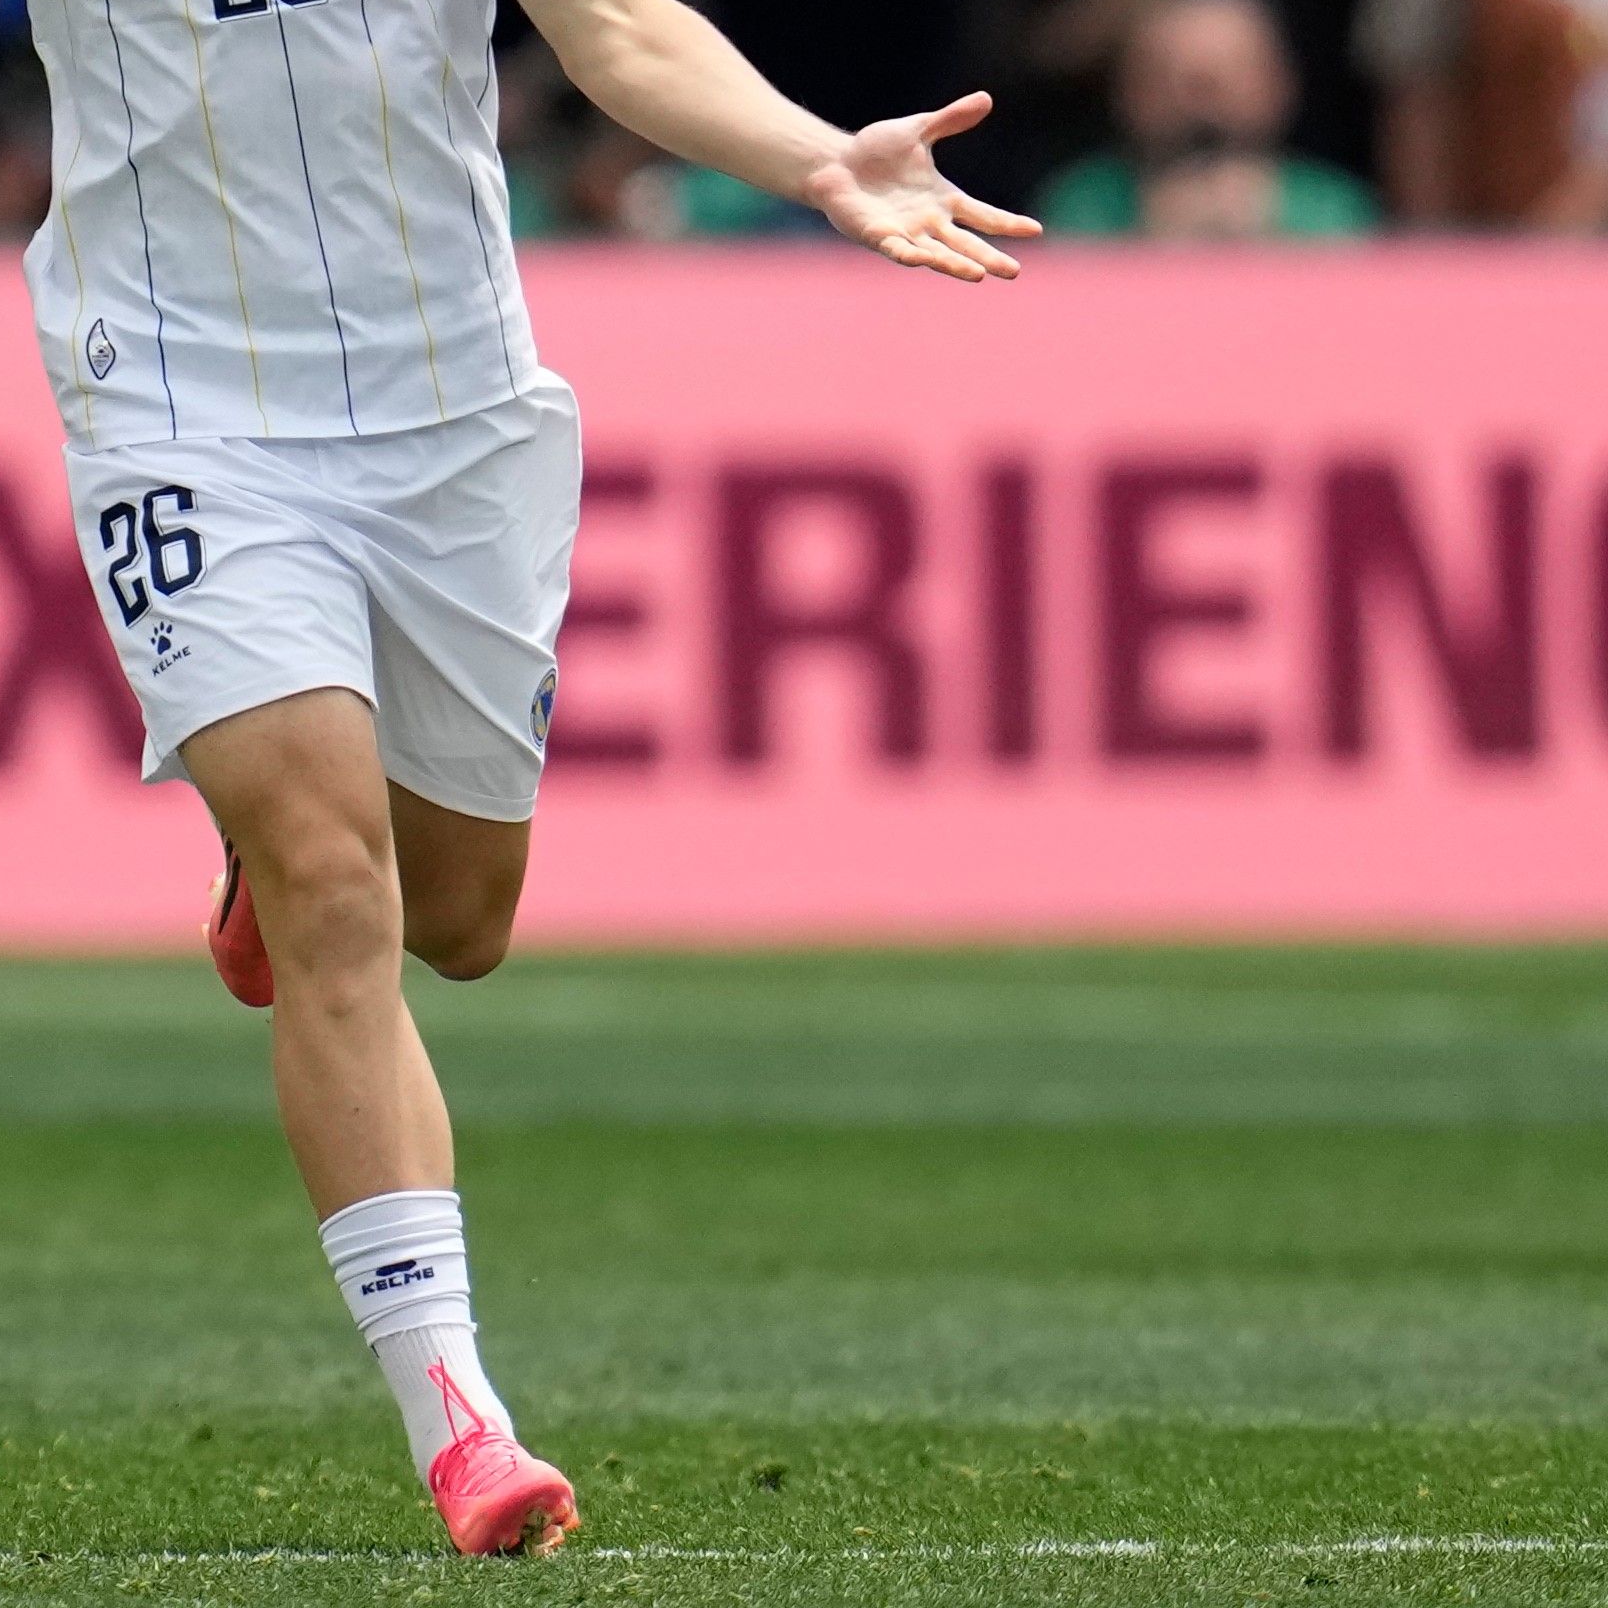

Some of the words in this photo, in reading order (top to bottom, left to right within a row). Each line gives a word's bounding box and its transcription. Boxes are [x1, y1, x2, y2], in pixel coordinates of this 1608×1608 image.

[98, 483, 208, 628] 26
[152, 645, 191, 677] KELME
[361, 1267, 435, 1296] KELME
